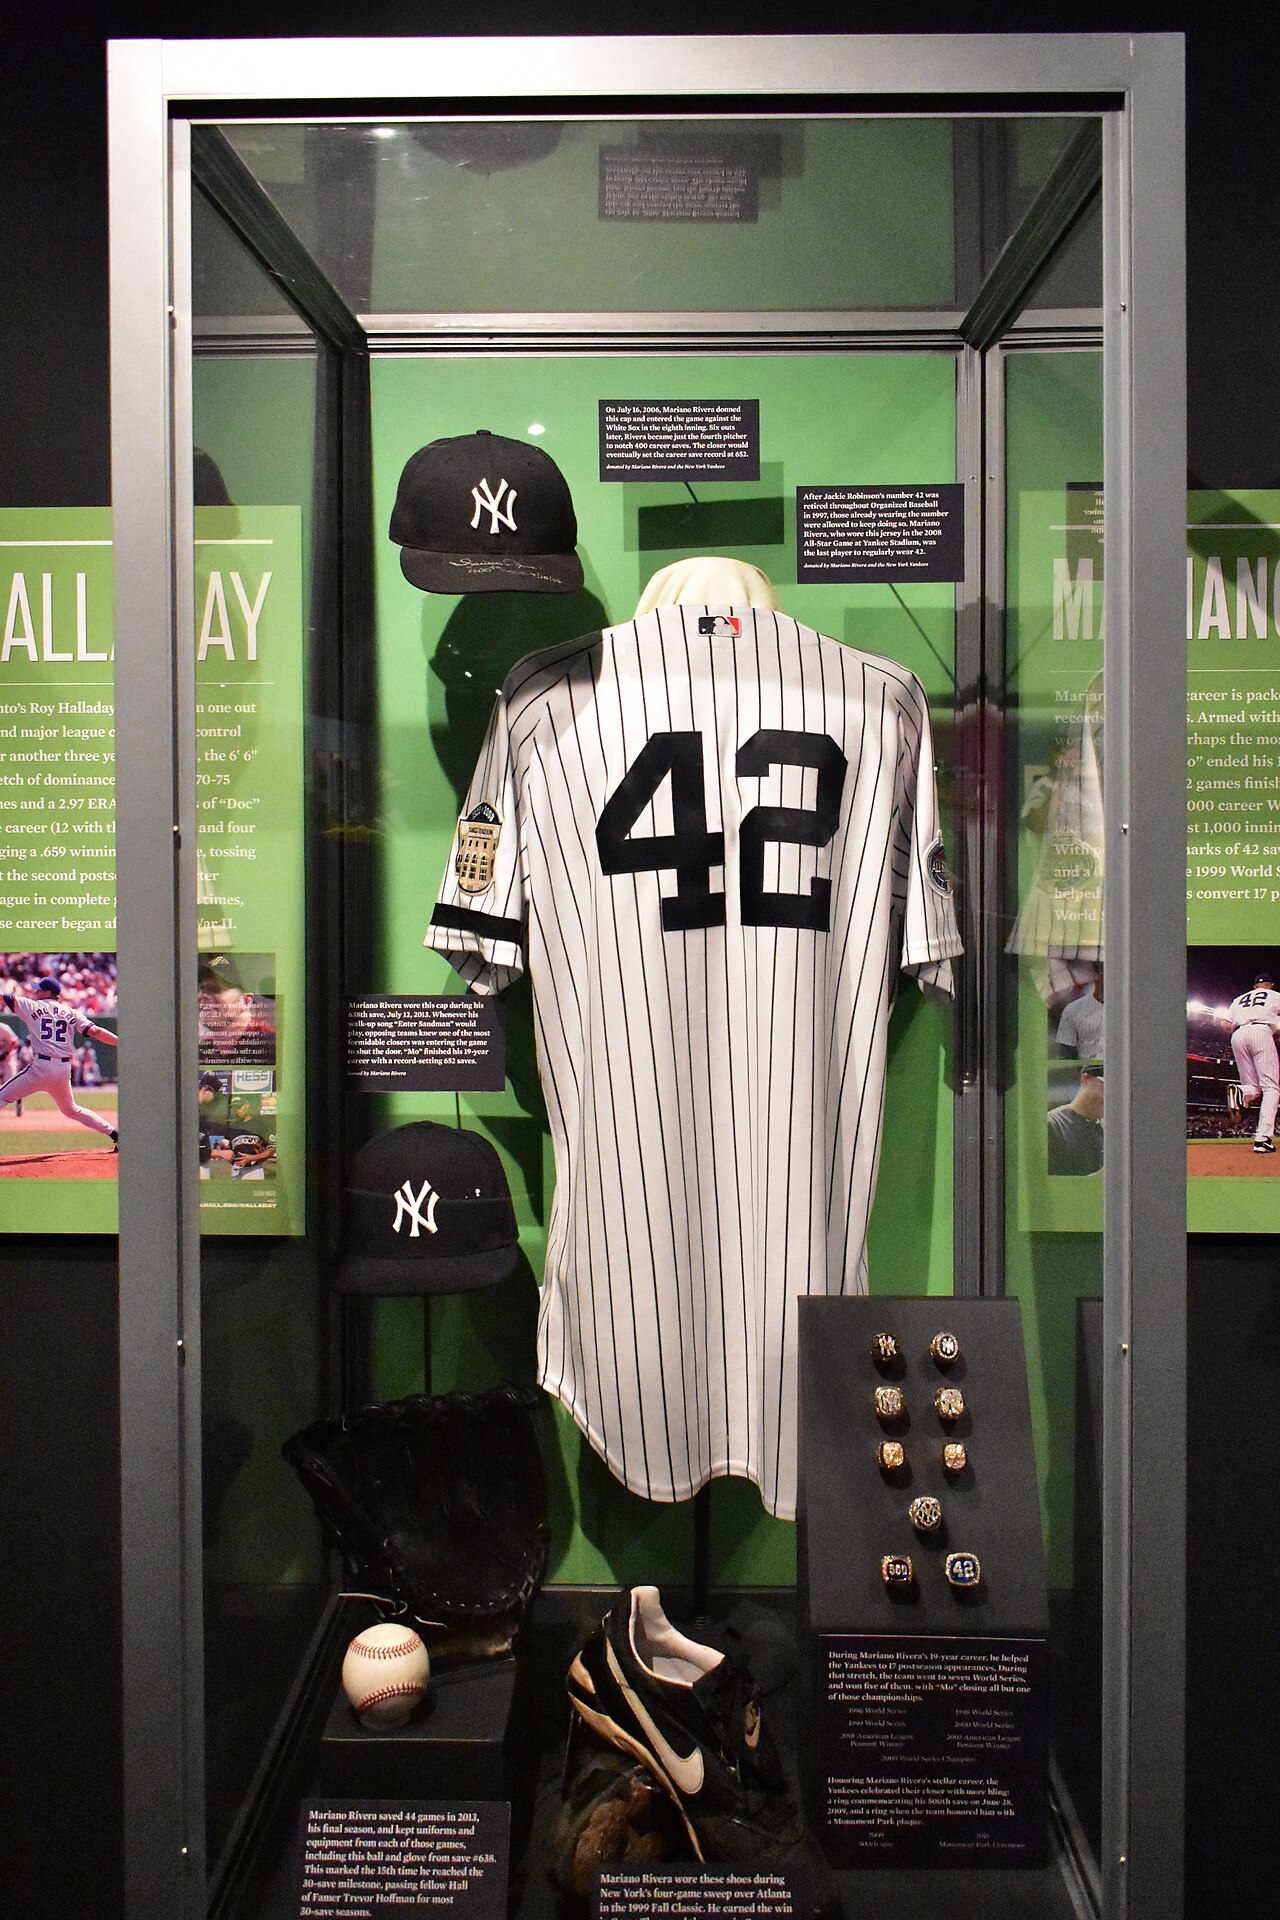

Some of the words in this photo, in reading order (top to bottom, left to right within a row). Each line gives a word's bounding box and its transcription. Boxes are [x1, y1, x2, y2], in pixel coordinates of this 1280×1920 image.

[617, 406, 631, 414] July
[633, 406, 642, 414] 16,
[643, 406, 661, 414] 2006,
[705, 415, 729, 423] against
[662, 424, 683, 432] eighth
[684, 424, 708, 432] inning.
[824, 492, 846, 500] Jackie
[886, 491, 913, 499] number
[829, 502, 869, 510] throughout
[870, 501, 907, 510] Organized
[812, 511, 829, 519] 1997,
[850, 511, 877, 519] already
[878, 511, 907, 519] wearing
[1232, 688, 1242, 701] is
[30, 702, 55, 716] Roy
[58, 701, 115, 716] Halladay
[208, 704, 231, 713] one
[234, 703, 256, 713] out
[1198, 710, 1245, 723] Armed
[21, 726, 59, 740] major
[62, 726, 105, 740] league
[196, 725, 242, 737] control
[1230, 733, 1252, 745] the
[10, 749, 61, 761] another
[64, 749, 100, 761] three
[205, 749, 226, 761] the
[1207, 755, 1248, 767] ended
[1253, 755, 1273, 767] his
[27, 773, 42, 786] of
[44, 773, 116, 786] dominance
[1196, 780, 1241, 792] games
[21, 797, 45, 809] and
[48, 801, 56, 809] a
[59, 798, 85, 810] 2.97
[202, 797, 218, 809] of
[1218, 802, 1263, 811] career
[5, 824, 47, 833] career
[51, 821, 69, 835] (12
[72, 821, 103, 833] with
[199, 821, 224, 833] and
[227, 821, 256, 833] four
[595, 728, 848, 933] 42
[1204, 822, 1241, 835] 1,000
[30, 849, 37, 857] a
[40, 846, 66, 857] .659
[70, 845, 116, 857] winnin
[210, 845, 256, 860] tossing
[1225, 843, 1241, 855] of
[1242, 844, 1259, 855] 42
[7, 869, 28, 881] the
[32, 869, 76, 881] second
[1054, 865, 1079, 877] and
[1196, 866, 1226, 877] 1999
[1230, 865, 1273, 877] World
[34, 893, 47, 905] in
[51, 893, 110, 908] complete
[203, 893, 244, 906] times,
[1054, 887, 1100, 902] helped
[1196, 890, 1250, 899] convert
[1254, 888, 1267, 899] 17
[1055, 908, 1097, 921] World
[16, 920, 58, 929] career
[62, 917, 101, 932] began
[449, 1002, 473, 1010] during
[1239, 992, 1268, 1008] 42
[387, 1011, 402, 1019] July
[41, 1018, 67, 1042] 52
[236, 1070, 269, 1083] HESS
[392, 1180, 440, 1237] NY
[953, 1560, 974, 1578] 42
[309, 1810, 347, 1820] Mariano
[348, 1811, 377, 1820] Rivera
[379, 1811, 403, 1821] saved
[418, 1814, 445, 1823] games
[601, 1873, 640, 1883] Mariano
[642, 1873, 672, 1883] Rivera
[700, 1874, 724, 1883] these
[726, 1874, 752, 1883] shoes
[754, 1874, 785, 1886] during
